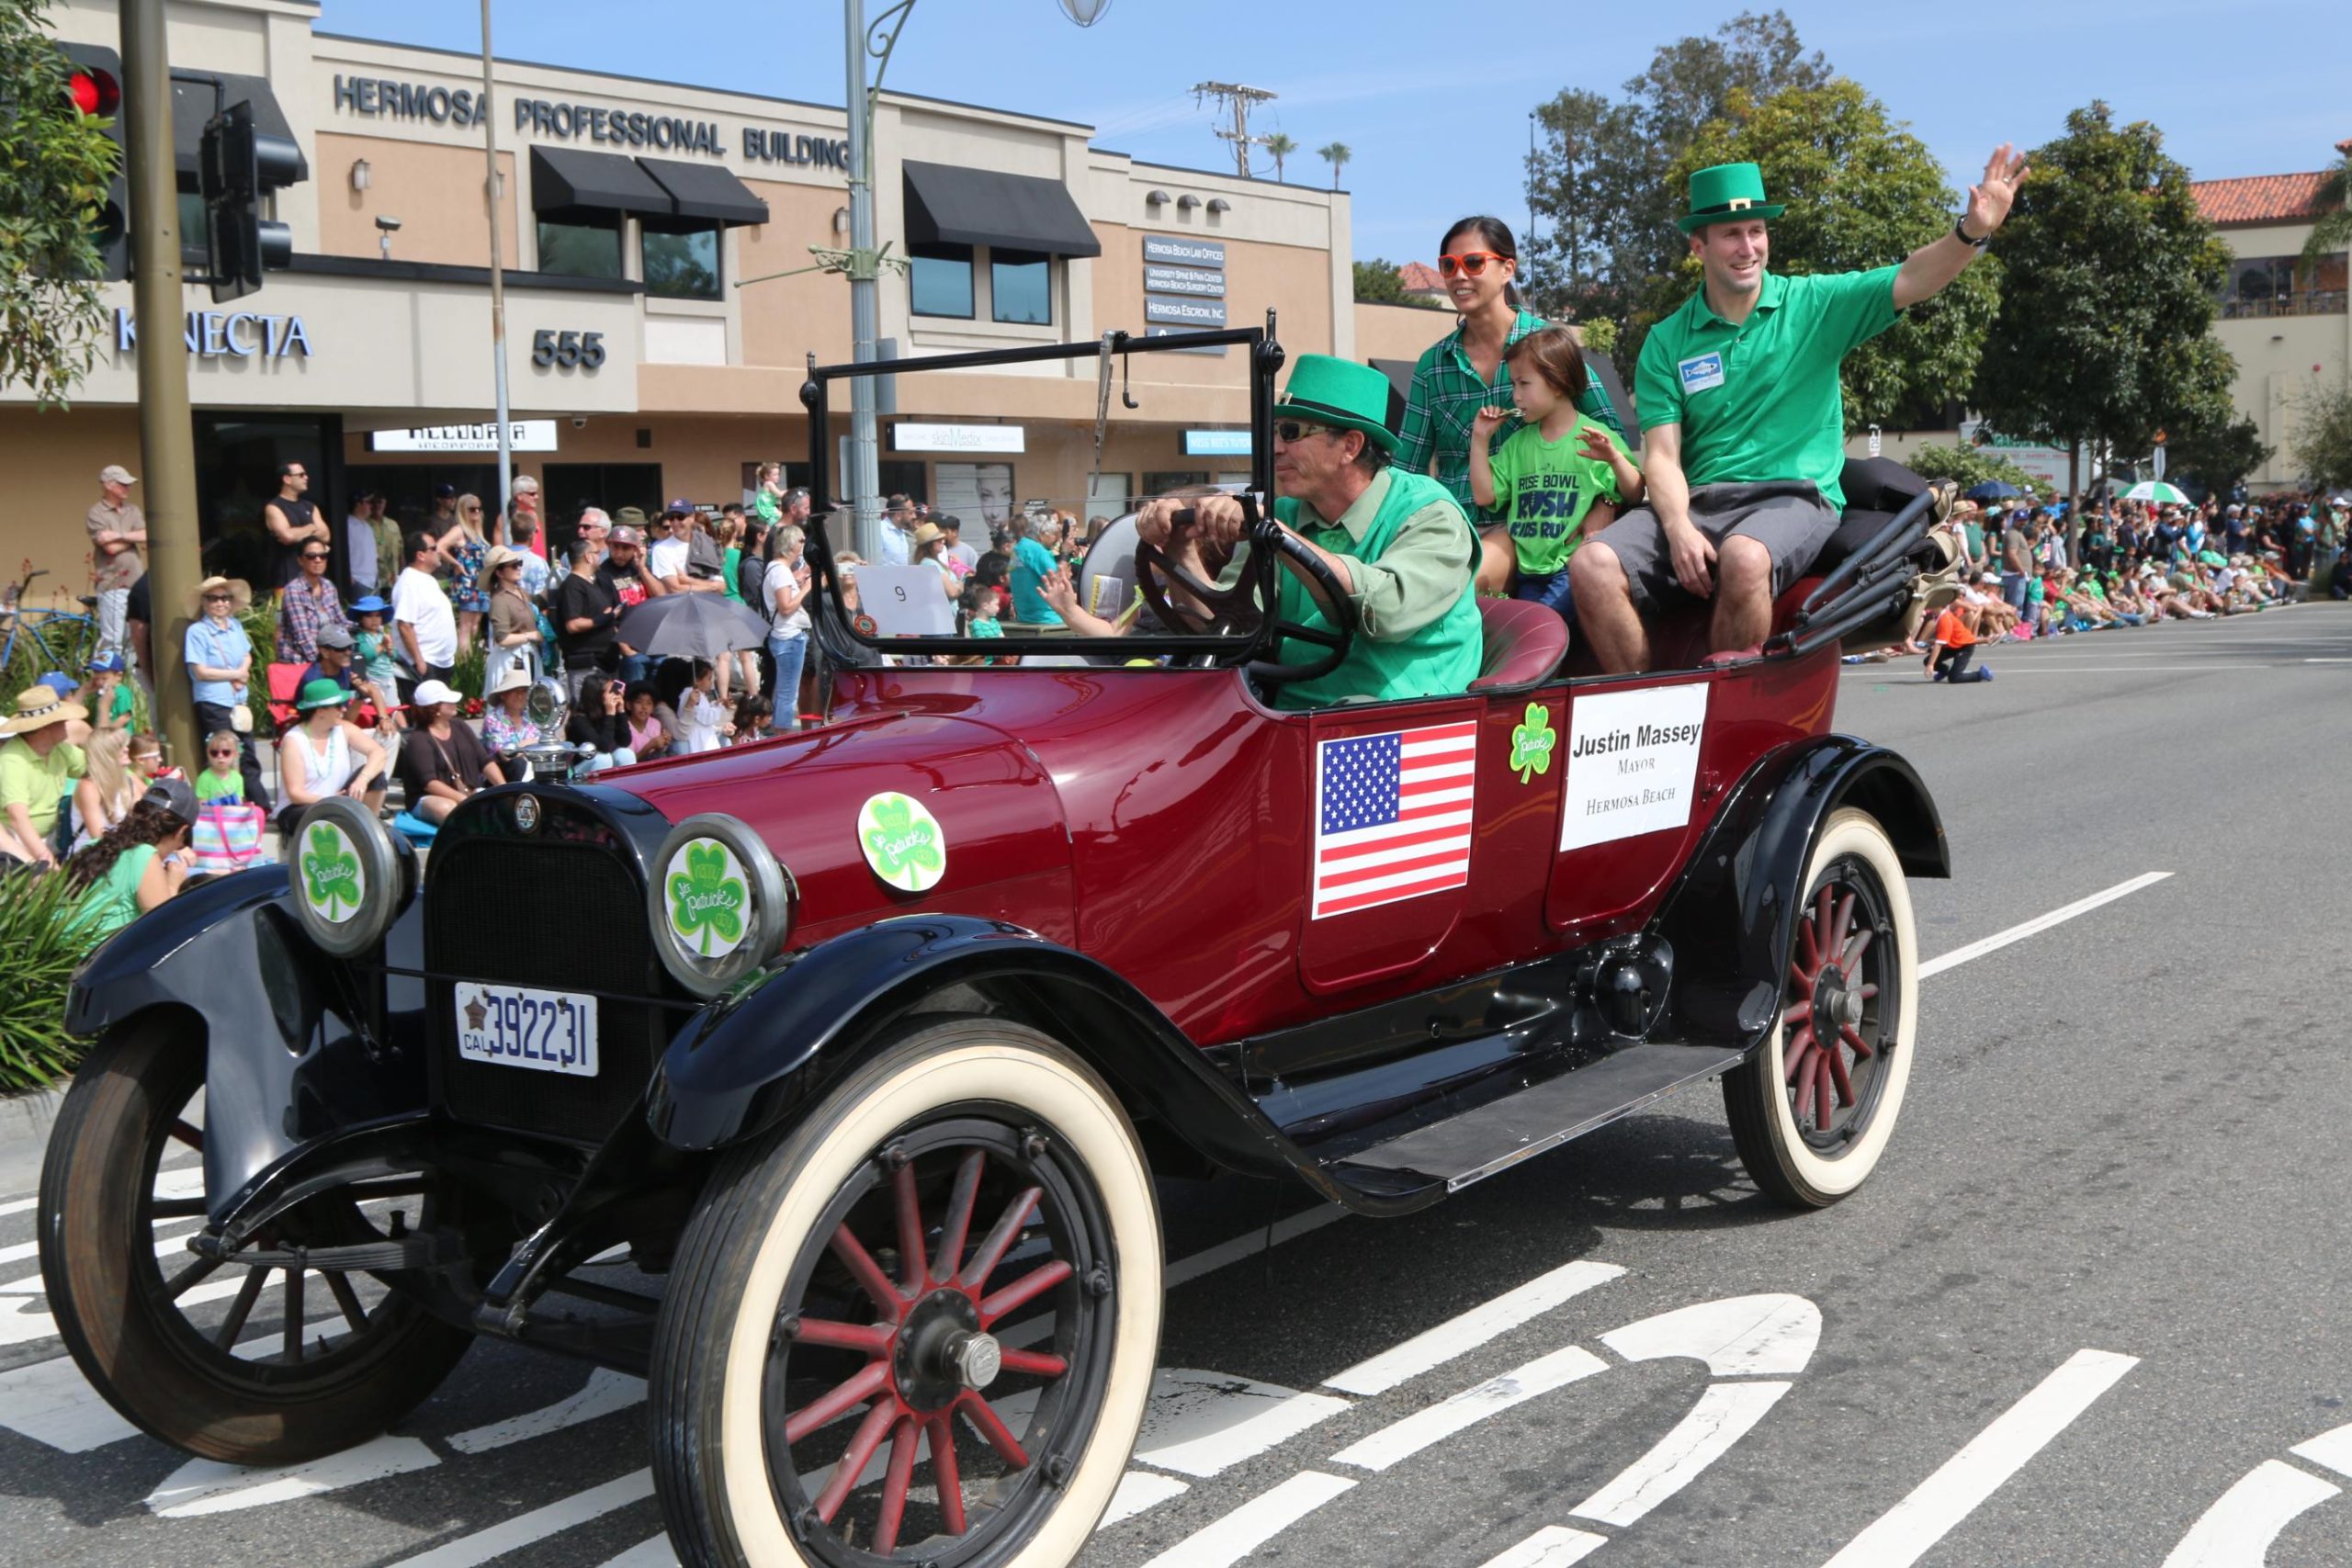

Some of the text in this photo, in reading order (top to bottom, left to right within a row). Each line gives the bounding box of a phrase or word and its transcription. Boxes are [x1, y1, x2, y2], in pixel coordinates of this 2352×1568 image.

[334, 73, 849, 170] HERMOSA PROFESSIONAL BUILDING
[1148, 243, 1172, 254] HERMOSA
[1173, 244, 1191, 256] BEACH
[1203, 249, 1224, 261] OFFICES
[1148, 278, 1170, 288] HERMOSA
[1207, 284, 1225, 293] CENTER
[1148, 302, 1182, 315] HERMOSA
[115, 308, 314, 356] KNECTA
[532, 330, 605, 368] 555
[1543, 475, 1579, 489] BOWL
[1517, 490, 1578, 519] RUSH
[894, 585, 907, 602] 9
[1573, 723, 1701, 759] Justin Massey
[1617, 758, 1656, 775] MAYOR
[1586, 787, 1676, 816] HERMOSA BEACH
[487, 996, 586, 1066] 392231
[464, 1034, 490, 1053] CAL
